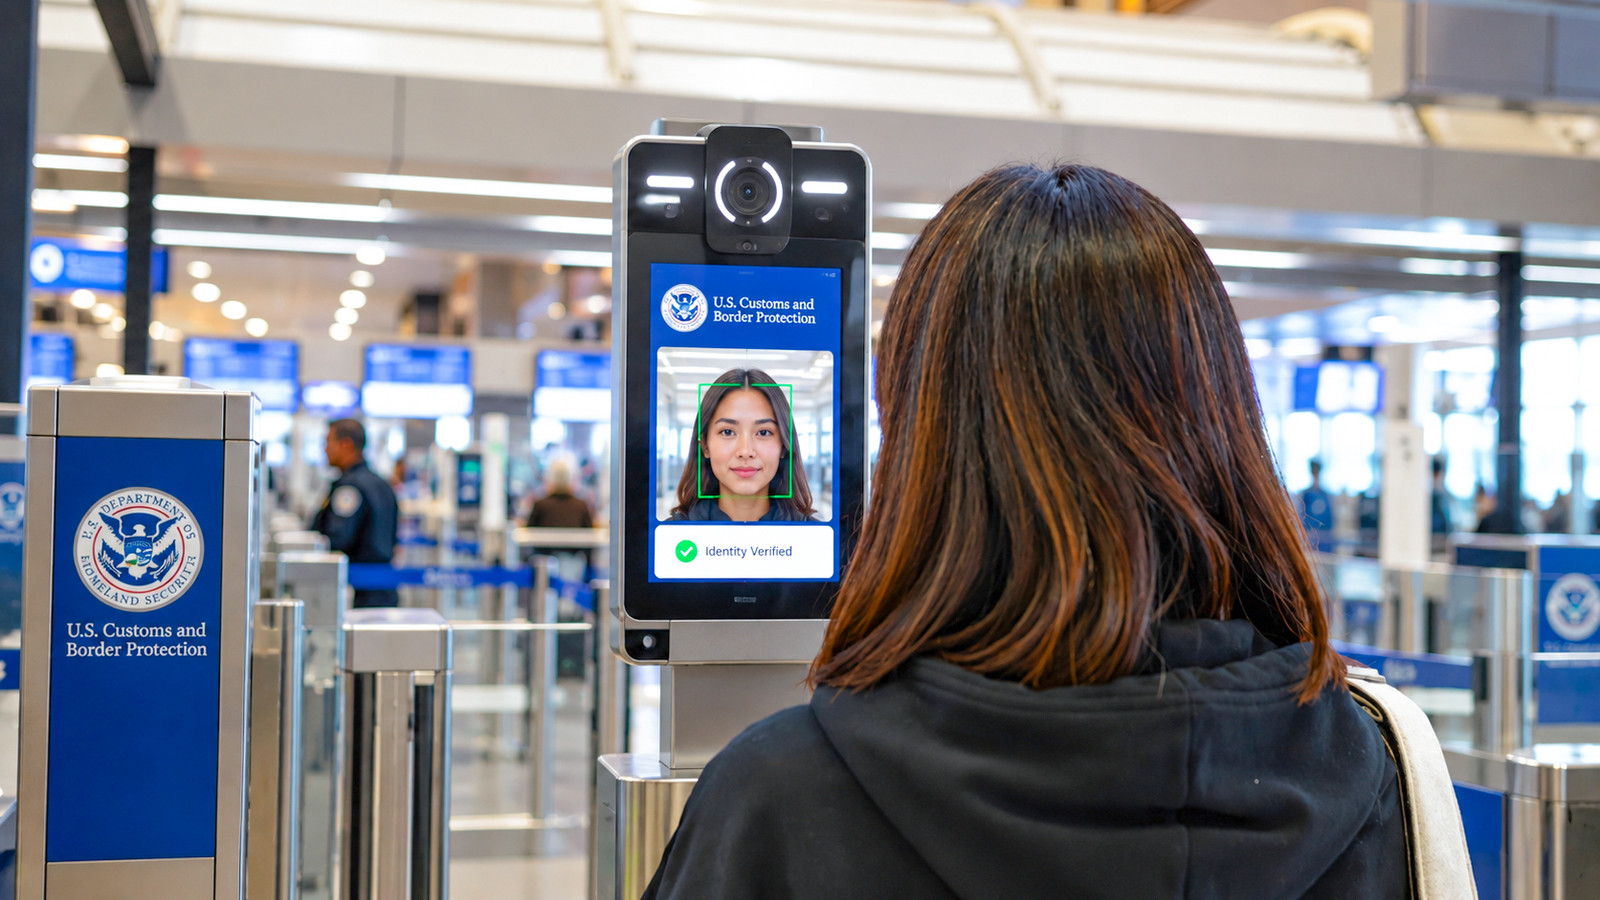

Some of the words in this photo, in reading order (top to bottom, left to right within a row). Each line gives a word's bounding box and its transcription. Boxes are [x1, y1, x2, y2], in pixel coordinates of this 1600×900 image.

[713, 296, 737, 309] U.S.
[739, 296, 791, 310] Customs
[792, 298, 815, 310] and
[713, 310, 754, 323] Border
[756, 311, 816, 324] Protection
[100, 493, 187, 521] DEPARTMENT
[705, 545, 747, 559] Identity
[750, 545, 793, 557] Verified
[67, 622, 99, 638] U.S.
[102, 622, 173, 638] Customs
[176, 622, 207, 638] and
[66, 641, 122, 657] Border
[126, 641, 208, 657] Protection
